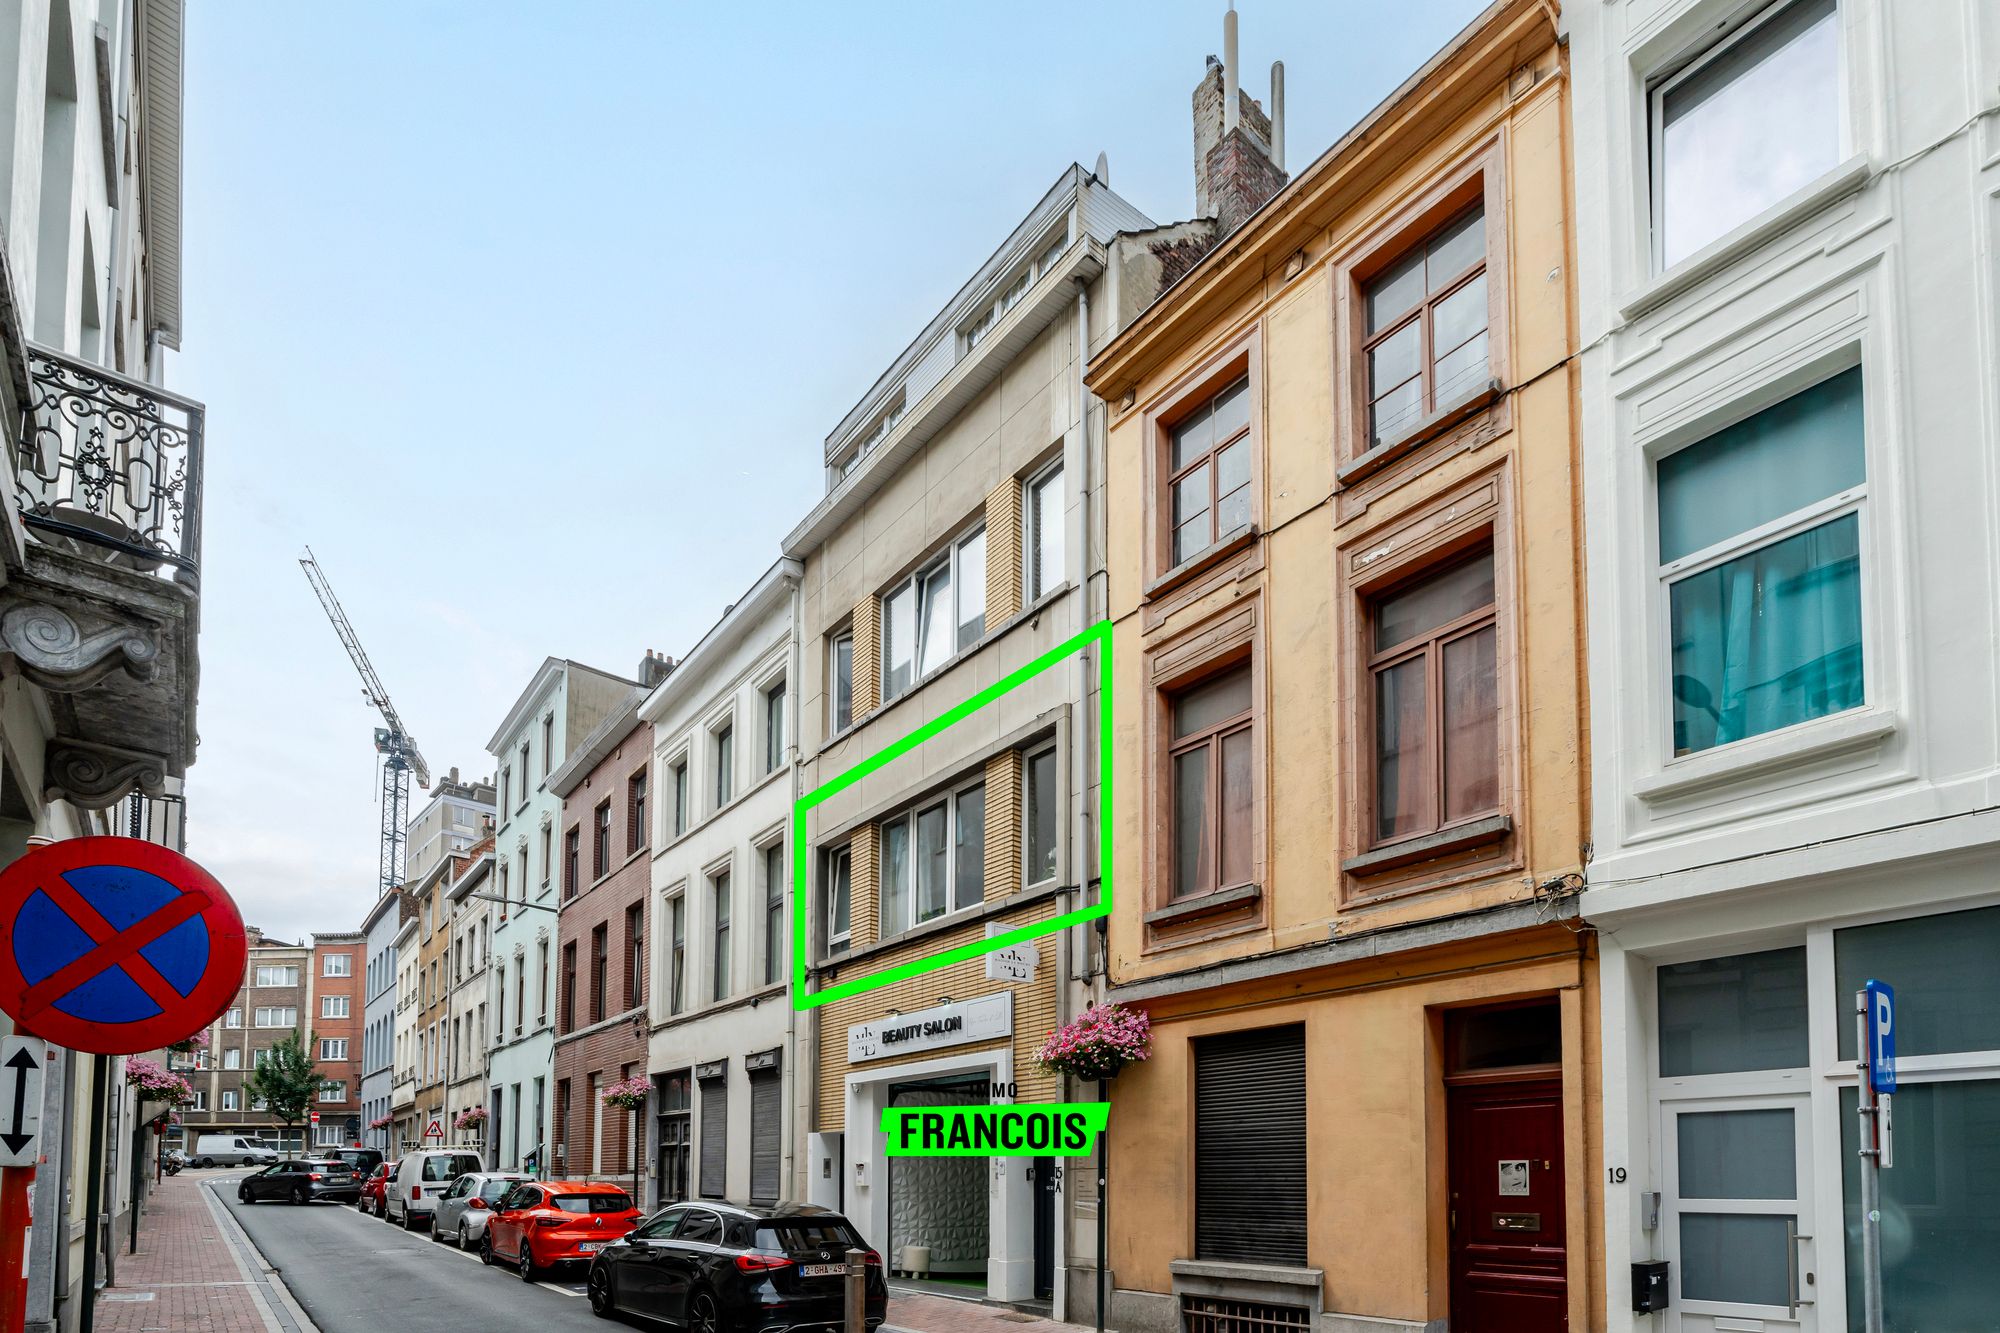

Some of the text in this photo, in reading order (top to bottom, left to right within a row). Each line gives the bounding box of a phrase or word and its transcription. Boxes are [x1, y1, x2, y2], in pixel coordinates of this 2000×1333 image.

[882, 1023, 923, 1044] BEAUTY
[924, 1015, 962, 1036] SALON
[1876, 991, 1892, 1066] P
[1055, 1180, 1062, 1193] A
[1608, 1167, 1627, 1184] 19
